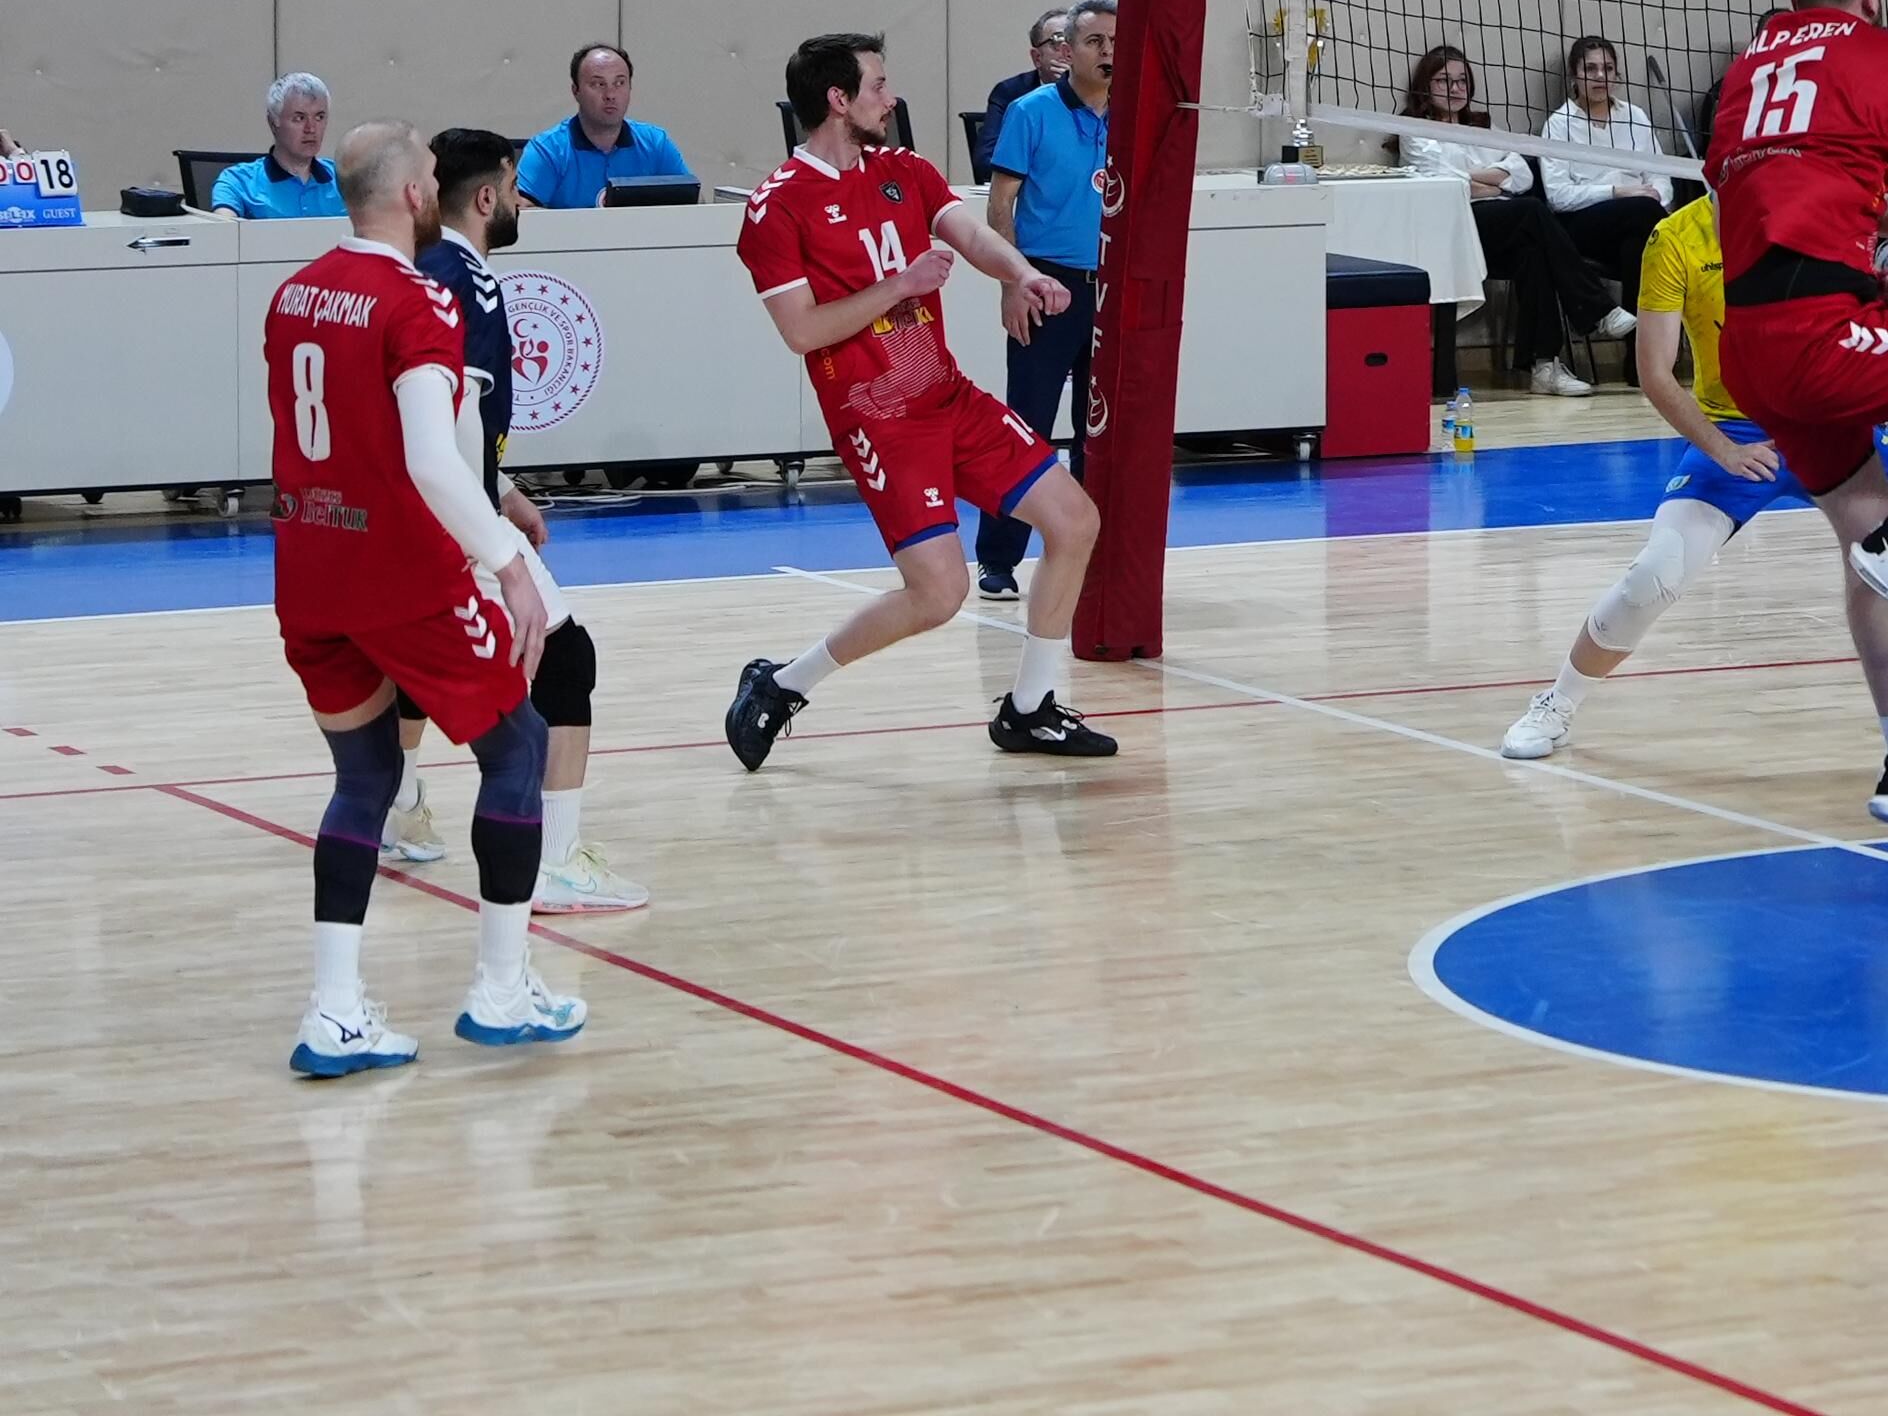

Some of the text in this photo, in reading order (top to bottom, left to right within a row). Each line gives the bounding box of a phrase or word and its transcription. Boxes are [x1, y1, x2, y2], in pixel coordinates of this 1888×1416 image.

[1743, 46, 1825, 141] 15
[41, 159, 73, 189] 18
[43, 208, 76, 219] GUEST
[858, 220, 908, 282] 14
[277, 284, 377, 328] MURAT ÇAKMAK
[508, 301, 549, 314] GENÇLİK
[550, 310, 561, 322] VE
[560, 321, 575, 346] SPOR
[293, 342, 331, 462] 8
